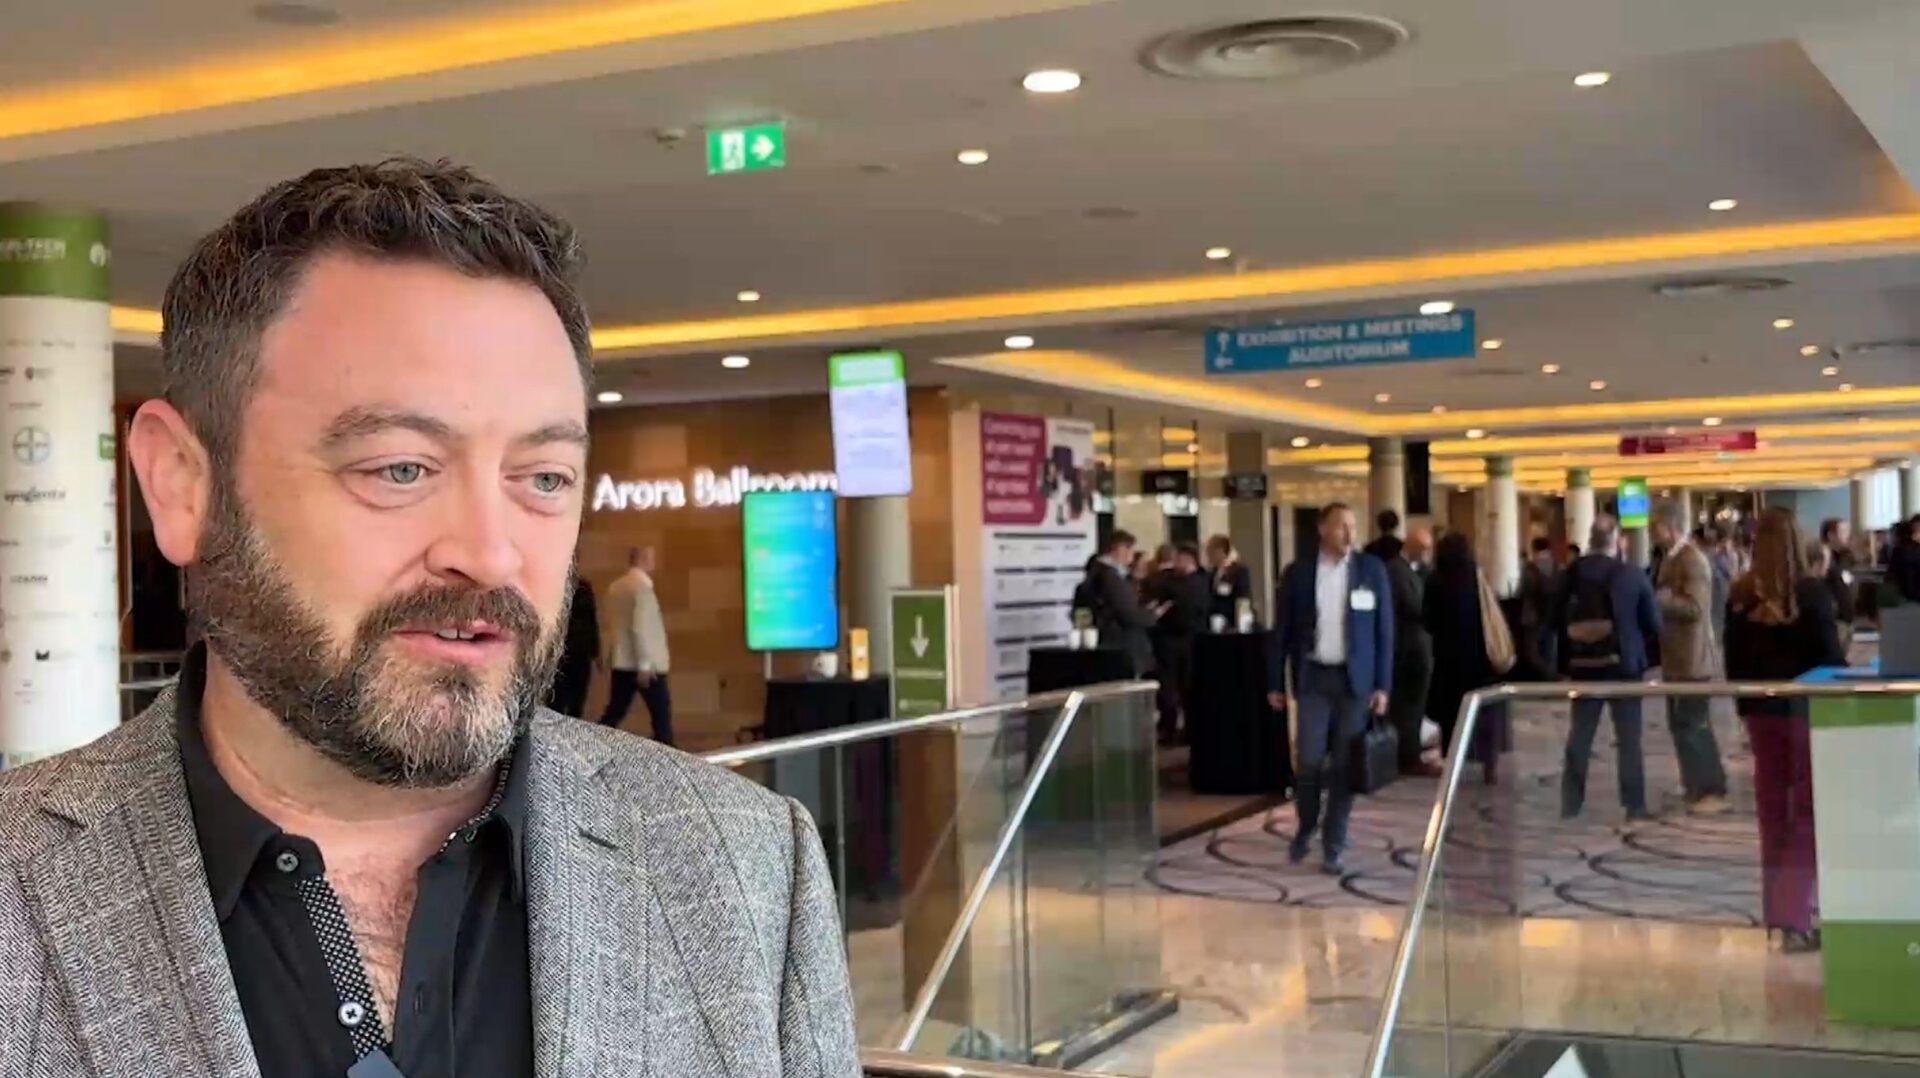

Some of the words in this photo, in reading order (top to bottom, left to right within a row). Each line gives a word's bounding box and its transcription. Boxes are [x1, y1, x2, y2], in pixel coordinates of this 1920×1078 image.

[1237, 325, 1342, 347] EXHIBITION
[1346, 323, 1360, 339] &
[1363, 313, 1464, 337] MEETINGS
[1288, 340, 1410, 364] AUDITORIUM
[592, 473, 687, 511] Arora
[693, 465, 838, 508] Ballroom
